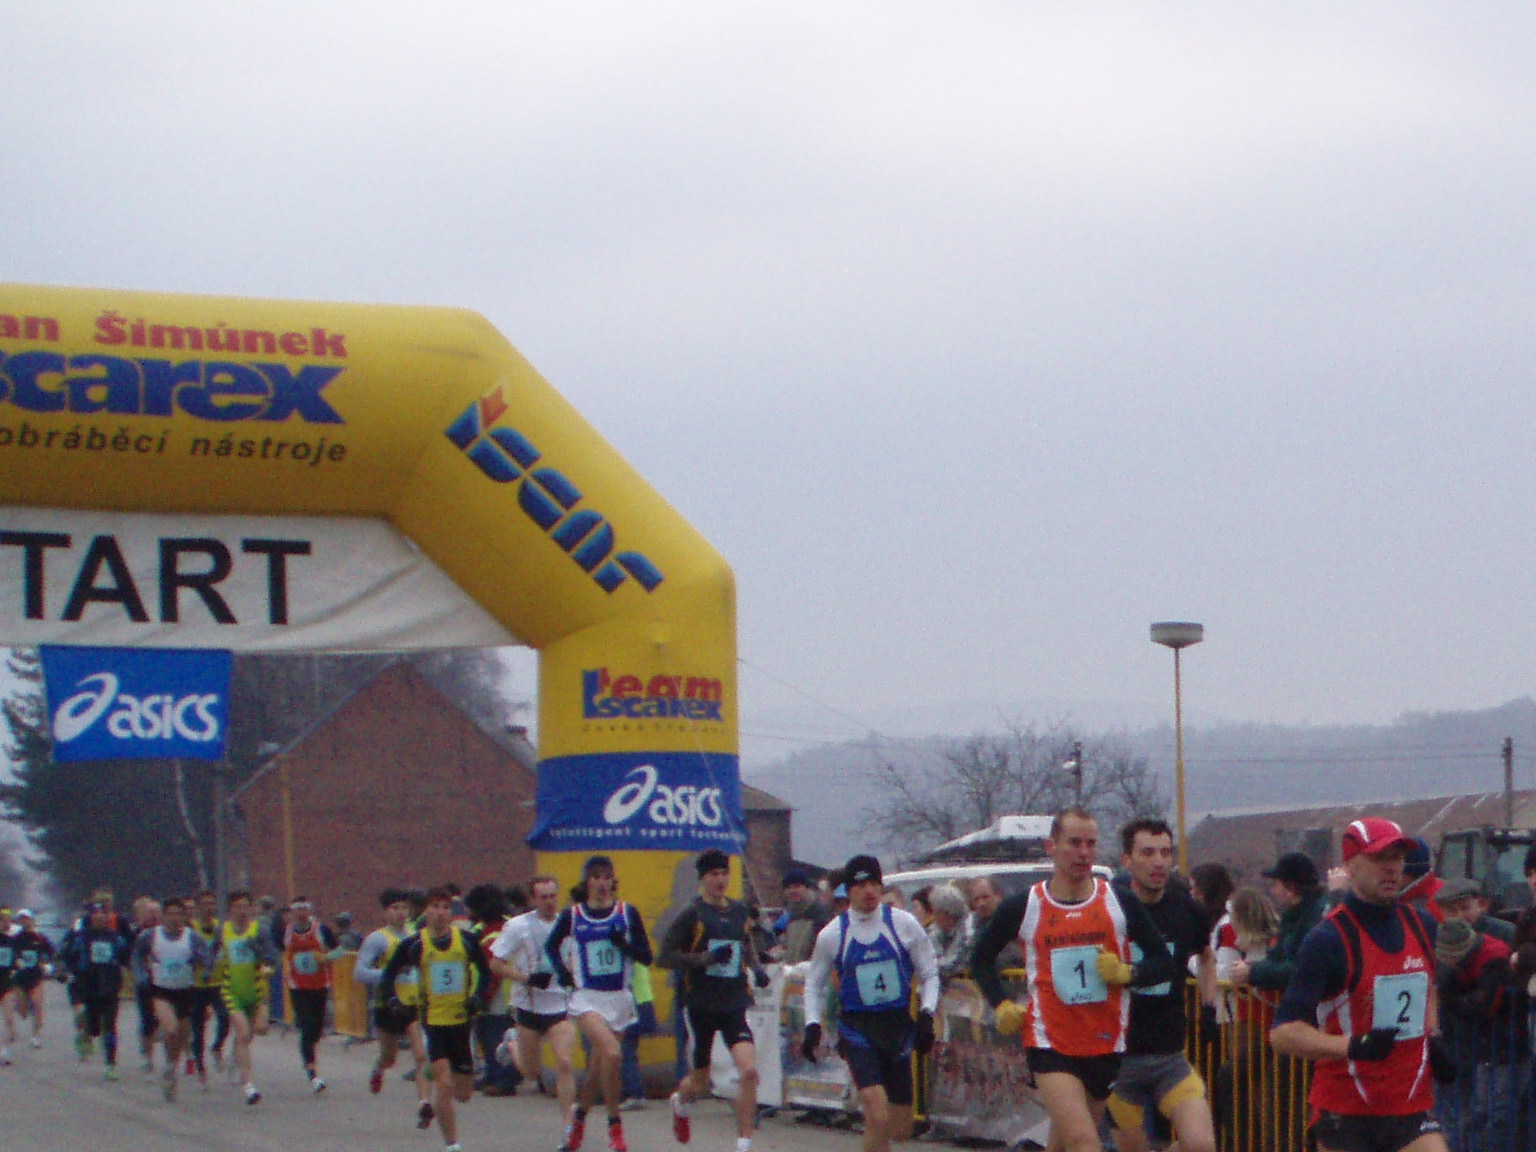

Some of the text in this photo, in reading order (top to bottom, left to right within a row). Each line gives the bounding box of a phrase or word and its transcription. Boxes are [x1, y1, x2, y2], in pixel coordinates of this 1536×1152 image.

[190, 432, 348, 466] nástroje
[598, 667, 723, 702] team
[596, 948, 615, 966] 10
[875, 972, 887, 992] 4
[1074, 959, 1086, 988] 1
[1396, 990, 1411, 1023] 2
